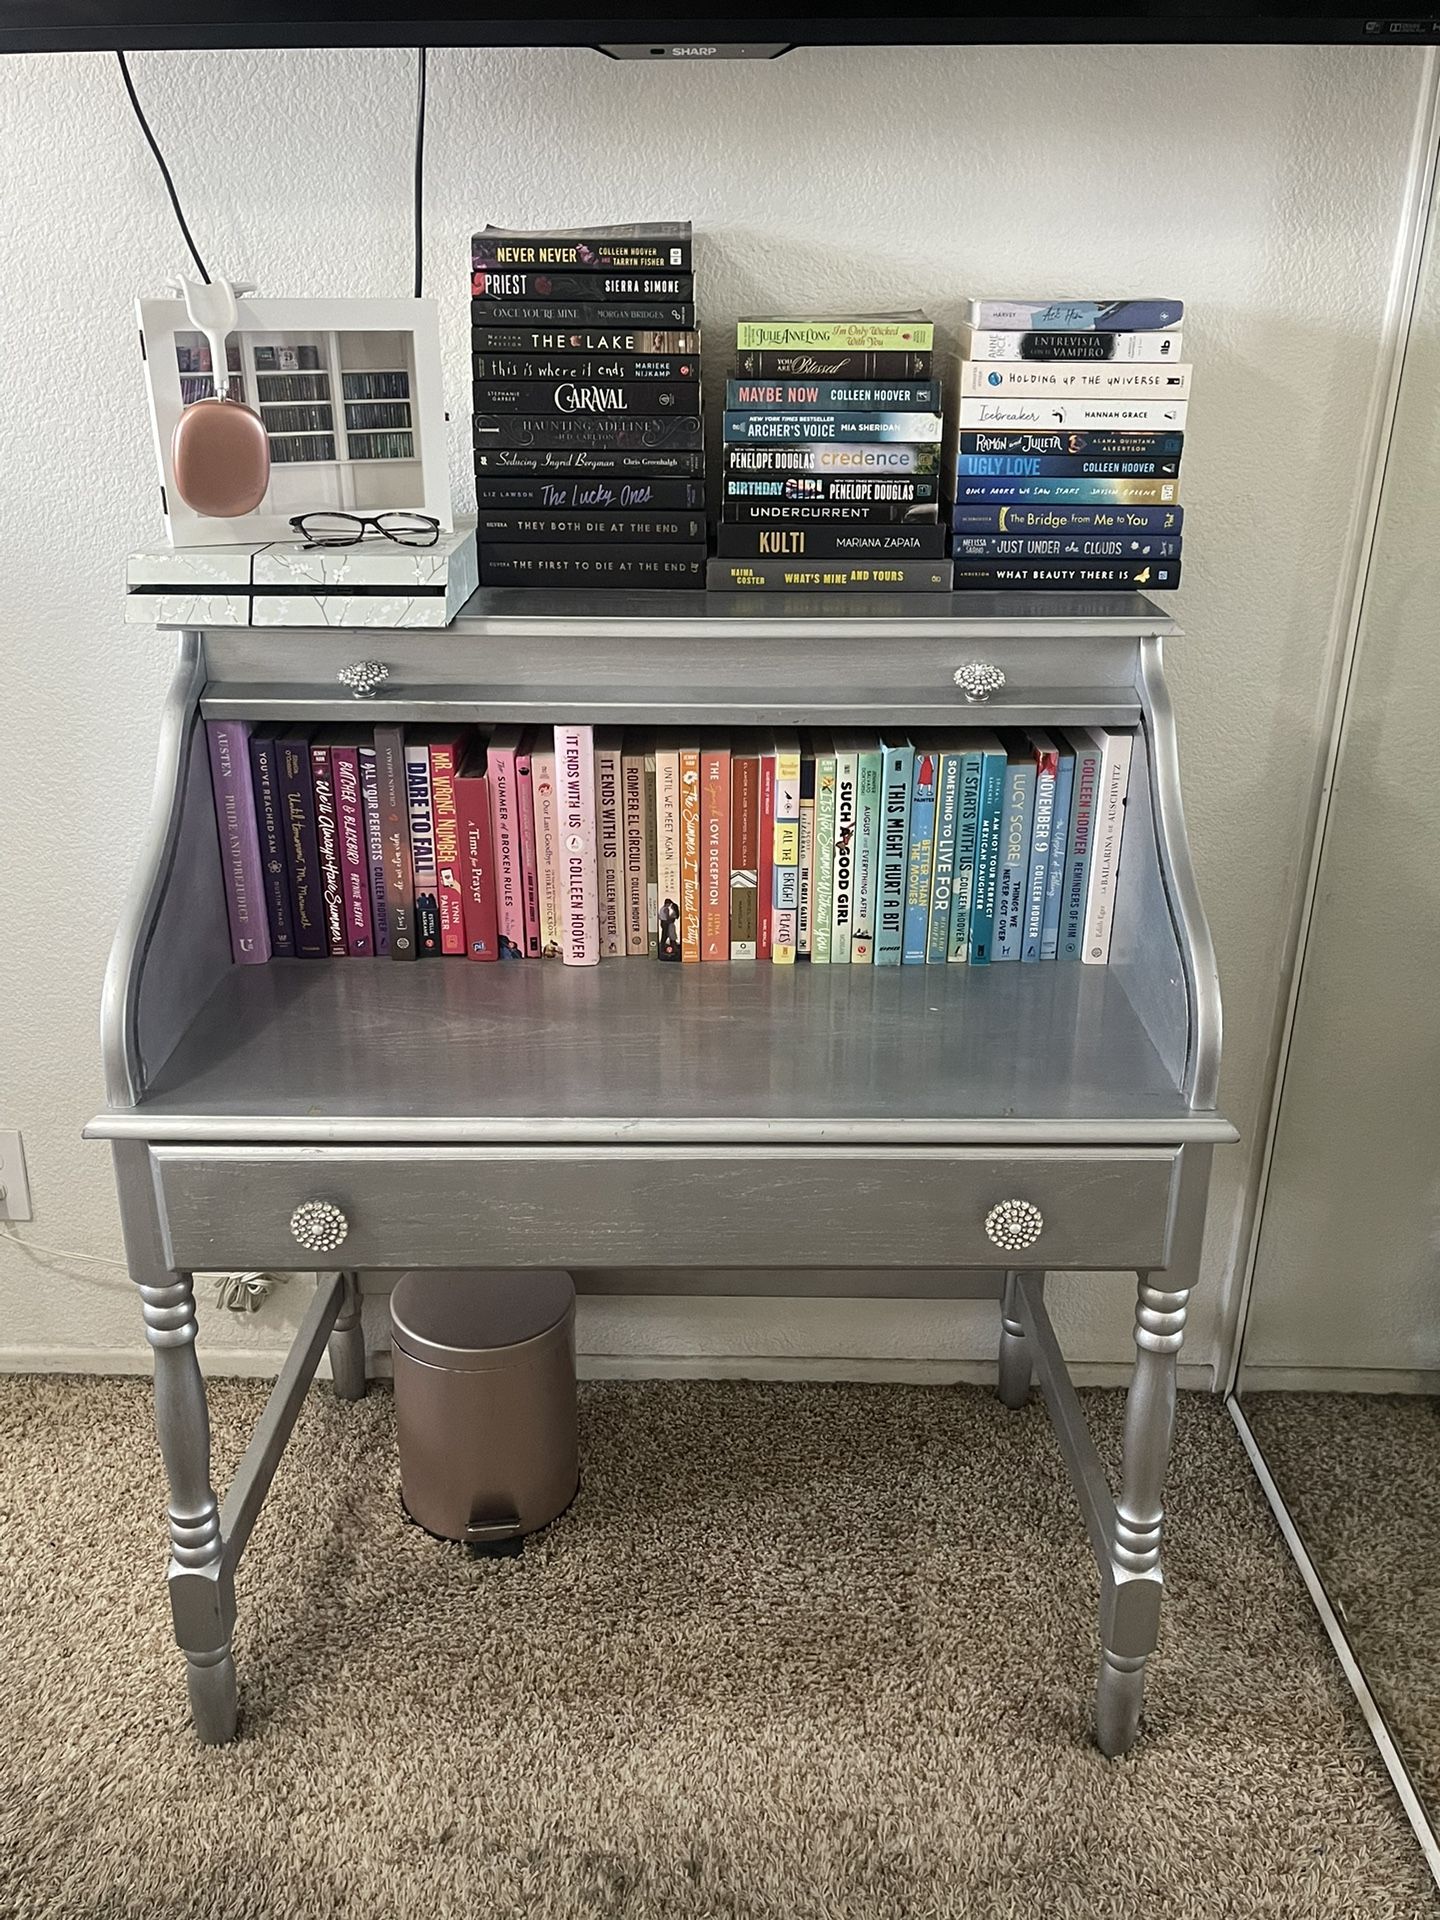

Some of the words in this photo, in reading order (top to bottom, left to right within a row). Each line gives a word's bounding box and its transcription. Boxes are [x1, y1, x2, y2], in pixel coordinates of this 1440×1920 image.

[672, 48, 717, 56] SHARP
[497, 248, 534, 262] NEVER
[539, 248, 577, 262] NEVER
[613, 258, 639, 266] TARRYN
[640, 258, 664, 266] FISHER
[485, 275, 527, 295] PRIEST
[605, 280, 639, 293] SIERRA
[644, 280, 679, 293] SIMONE
[532, 335, 566, 348] THE
[586, 335, 634, 350] LAKE
[1053, 347, 1104, 358] VAMPIRO
[554, 383, 627, 412] CARAVAL
[739, 387, 783, 403] MAYBE
[788, 387, 818, 403] NOW
[830, 389, 871, 401] COLLEEN
[874, 389, 911, 401] HOOVER
[978, 405, 1040, 422] Icebreaker
[1122, 411, 1147, 419] GRACE
[748, 424, 801, 437] ARCHER'S
[804, 424, 835, 437] VOICE
[841, 423, 857, 432] MIA
[858, 423, 900, 432] SHERIDAN
[496, 451, 537, 469] Seducing
[541, 452, 572, 468] Ingrid
[575, 452, 615, 469] Bergman
[730, 453, 773, 468] PENELOPE
[775, 453, 815, 469] DOUGLAS
[821, 451, 910, 466] credence
[968, 458, 1003, 476] UGLY
[1006, 458, 1041, 476] LOVE
[1083, 462, 1119, 472] COLLEEN
[1122, 463, 1155, 473] HOOVER
[541, 485, 566, 506] The
[572, 485, 616, 507] Lucky
[620, 485, 653, 507] Ones
[728, 481, 783, 496] BIRTHDAY
[785, 479, 825, 499] GIRL
[829, 484, 872, 500] PENELOPE
[874, 485, 914, 500] DOUGLAS
[750, 507, 870, 518] UNDERCURRENT
[1010, 514, 1025, 523] The
[1027, 512, 1067, 528] Bridge
[1071, 513, 1090, 523] from
[1094, 515, 1113, 525] Me
[1116, 515, 1124, 523] to
[1126, 515, 1148, 526] You
[518, 521, 545, 530] THEY
[551, 522, 581, 531] BOTH
[586, 523, 605, 531] DIE
[610, 523, 624, 532] AT
[630, 524, 650, 532] THE
[656, 524, 678, 533] END
[759, 532, 805, 553] KULTI
[836, 538, 881, 548] MARIANA
[884, 538, 920, 548] ZAPATA
[997, 540, 1023, 553] JUST
[1027, 541, 1060, 554] UNDER
[1084, 542, 1122, 555] CLOUDS
[513, 561, 533, 569] THE
[538, 561, 569, 570] FIRST
[575, 561, 589, 570] TO
[595, 562, 614, 570] DIE
[619, 562, 632, 570] AT
[639, 562, 659, 571] THE
[665, 563, 686, 571] END
[784, 573, 820, 584] WHAT'S
[823, 574, 847, 584] MINE
[850, 570, 869, 581] AND
[872, 571, 904, 581] YOURS
[996, 570, 1027, 579] WHAT
[1033, 570, 1074, 579] BEAUTY
[1081, 570, 1113, 579] THERE
[1119, 570, 1128, 579] IS
[566, 736, 578, 746] IT
[218, 732, 232, 778] AUSTEN
[431, 752, 451, 773] MR.
[566, 748, 579, 778] ENDS
[601, 759, 614, 770] IT
[259, 751, 270, 786] YOU'VE
[365, 762, 376, 779] ALL
[967, 762, 980, 774] IT
[407, 762, 429, 803] DARE
[601, 775, 615, 805] ENDS
[626, 767, 639, 810] ROMPER
[944, 760, 957, 821] SOMETHING
[1012, 774, 1026, 811] LUCY
[1079, 758, 1095, 809] COLLEEN
[366, 781, 378, 809] YOUR
[432, 775, 455, 815] WRONG
[567, 780, 580, 809] WITH
[840, 782, 852, 823] SUCH
[888, 783, 906, 813] THIS
[964, 776, 979, 819] STARTS
[263, 789, 275, 831] REACHED
[1036, 774, 1055, 841] NOVEMBER
[412, 810, 431, 833] TO
[569, 814, 581, 828] US
[602, 808, 616, 840] WITH
[628, 813, 639, 826] EL
[943, 824, 952, 837] TO
[267, 832, 276, 853] SAM
[368, 812, 383, 861] PERFECTS
[436, 819, 458, 863] NUMBER
[783, 829, 792, 845] ALL
[887, 819, 904, 859] MIGHT
[962, 822, 975, 853] WITH
[981, 820, 990, 861] MEXICAN
[1008, 815, 1023, 862] SCORE
[1073, 812, 1089, 855] HOOVER
[413, 838, 434, 873] FALL
[604, 843, 616, 858] US
[629, 829, 641, 872] CÍRCULO
[938, 839, 953, 872] LIVE
[1034, 843, 1049, 853] 9
[838, 843, 851, 890] GOOD
[959, 856, 972, 872] US
[569, 857, 583, 907] COLLEEN
[606, 869, 616, 900] COLLEEN
[782, 872, 794, 904] BRIGHT
[885, 864, 902, 896] HURT
[976, 864, 986, 910] DAUGHTER
[1002, 869, 1011, 897] NEVER
[1032, 865, 1044, 902] COLLEEN
[1070, 862, 1084, 909] REMINDERS
[884, 900, 899, 909] A
[935, 877, 950, 910] FOR
[1011, 880, 1021, 913] THINGS
[441, 895, 450, 931] PAINTER
[451, 901, 459, 924] LYNN
[607, 902, 616, 935] HOOVER
[837, 892, 849, 926] GIRL
[1000, 899, 1008, 917] GOT
[1068, 909, 1078, 922] OF
[779, 913, 791, 943] PLACES
[883, 911, 899, 933] BIT
[998, 917, 1007, 941] OVER
[1010, 915, 1017, 928] WE
[1028, 905, 1040, 938] HOOVER
[1067, 924, 1077, 939] HIM
[571, 909, 585, 959] HOOVER
